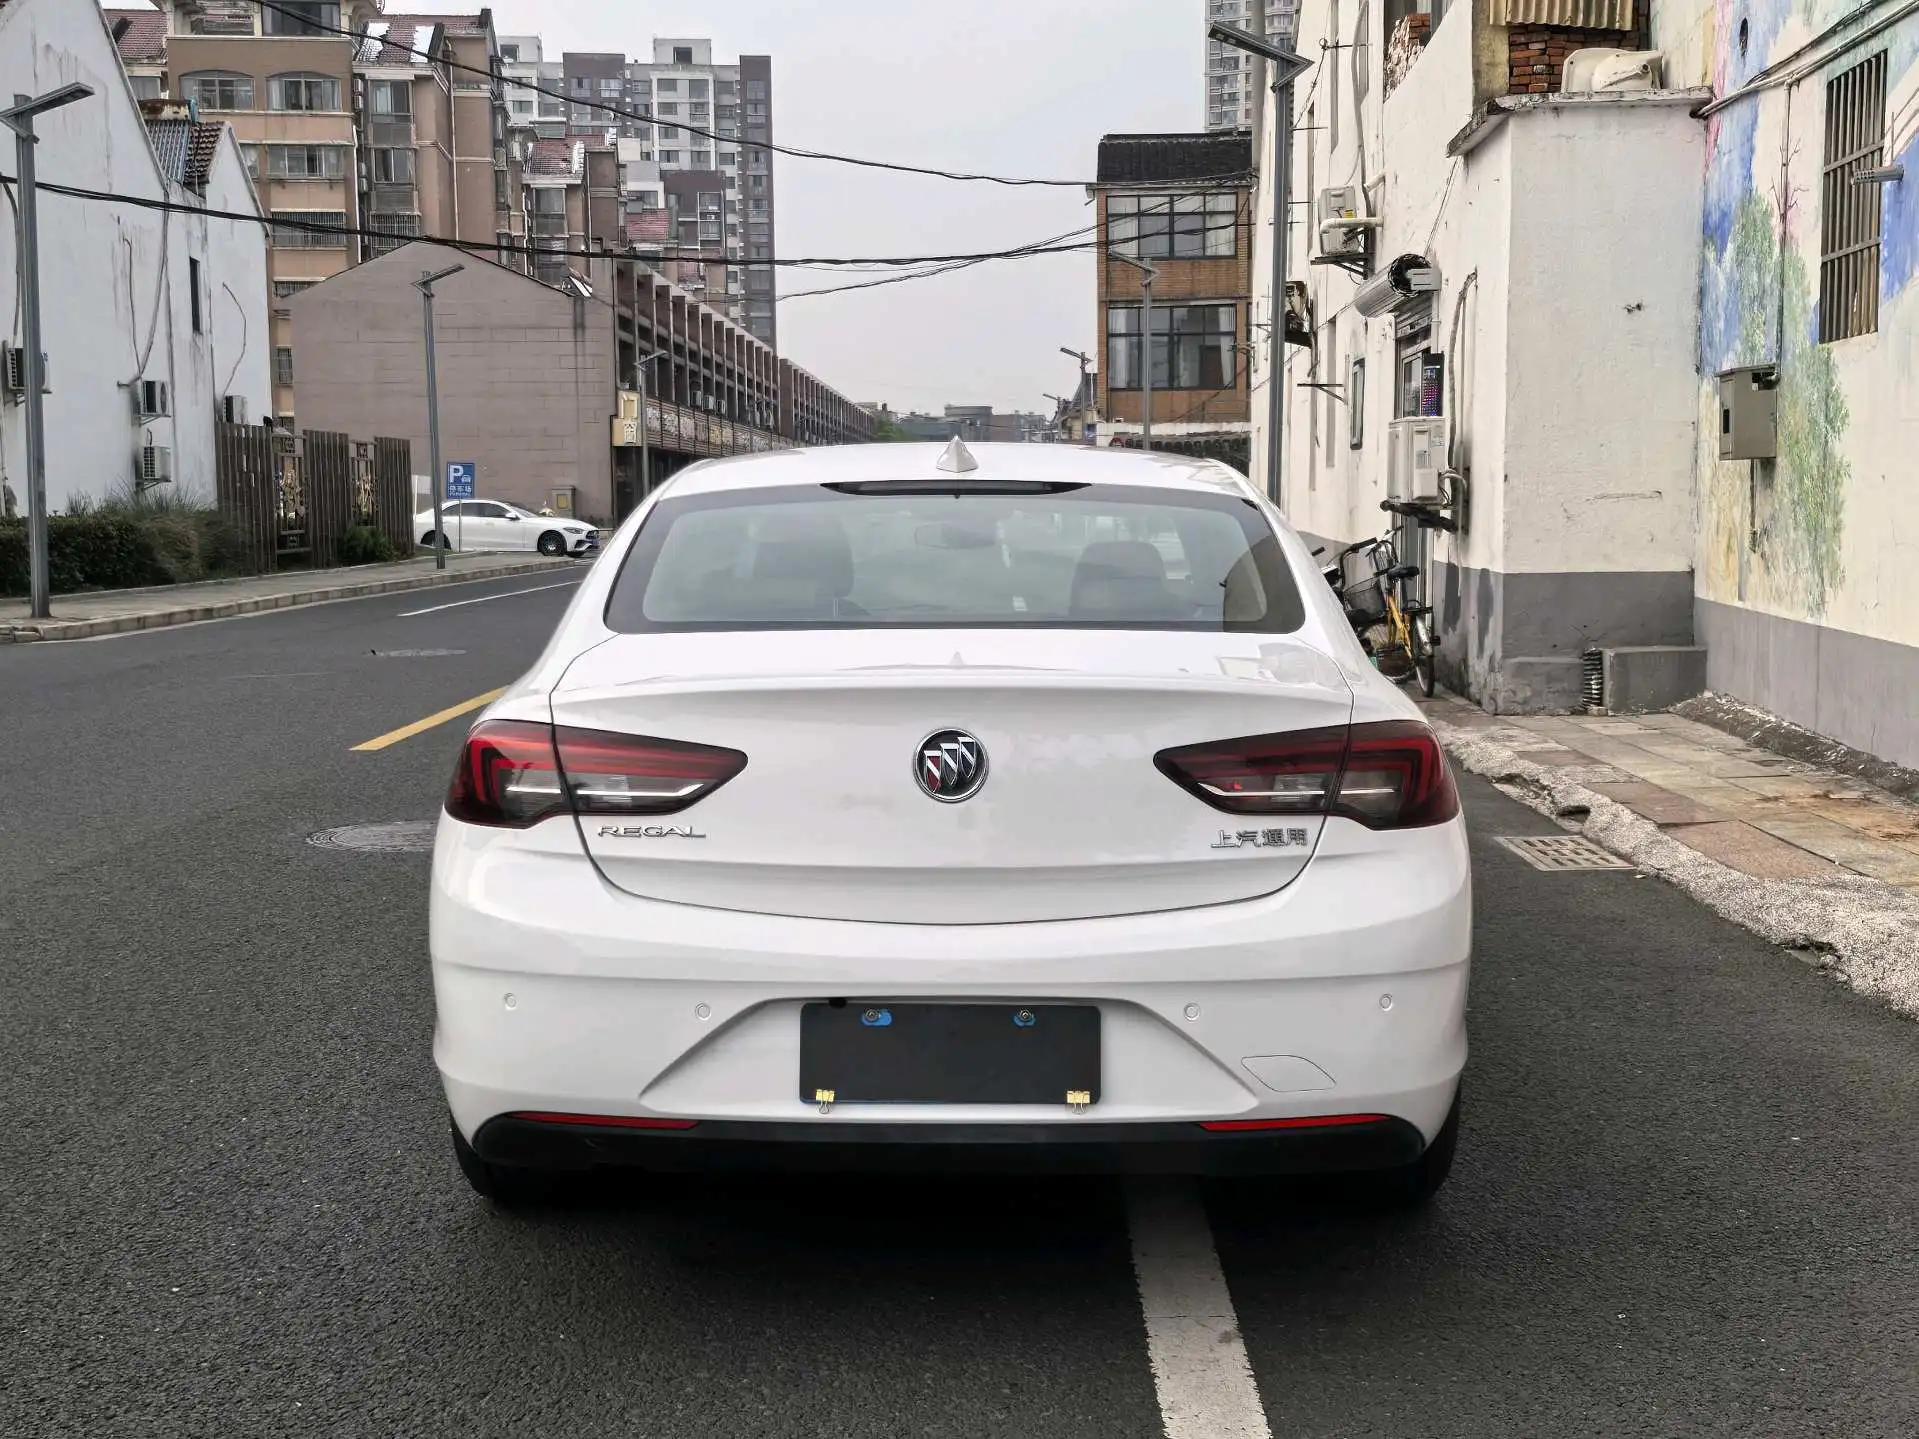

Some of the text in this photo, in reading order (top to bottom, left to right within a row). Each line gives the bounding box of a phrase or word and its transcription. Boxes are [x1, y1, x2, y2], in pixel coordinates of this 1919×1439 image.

[450, 465, 464, 483] P
[597, 825, 706, 838] REGAL
[1210, 828, 1308, 848] 上汽通用
